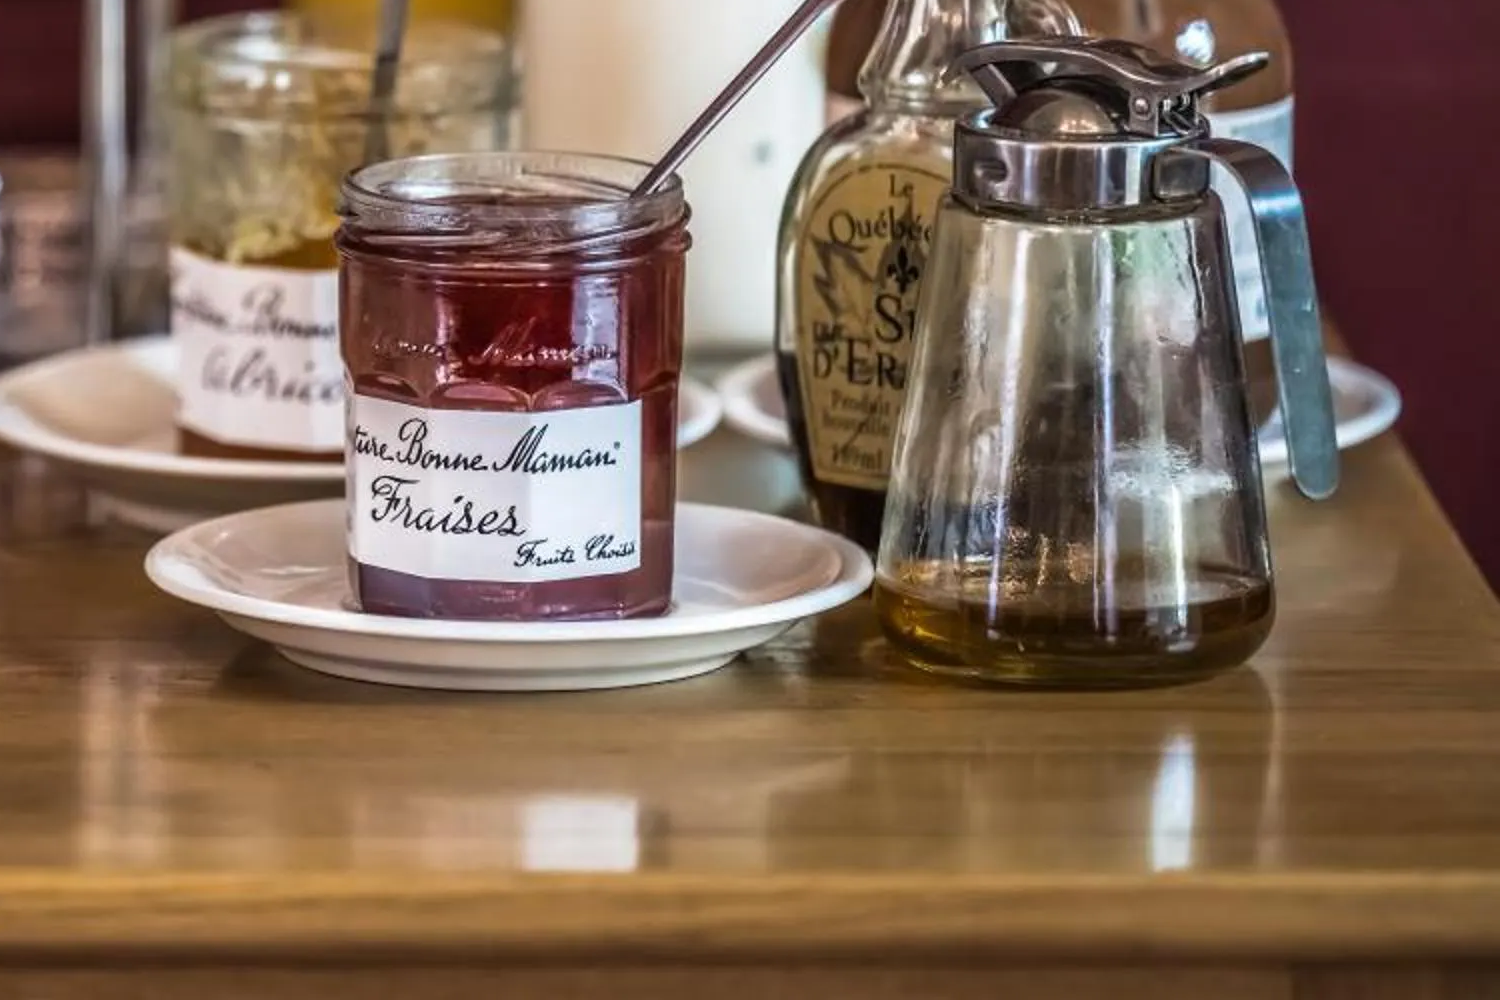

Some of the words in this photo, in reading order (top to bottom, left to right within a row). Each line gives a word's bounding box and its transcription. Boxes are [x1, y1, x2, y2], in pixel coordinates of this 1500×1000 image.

[889, 174, 915, 198] Le
[397, 417, 488, 470] Bonne
[492, 423, 617, 475] Maman
[371, 475, 527, 538] Fraises
[513, 537, 576, 568] Fruits
